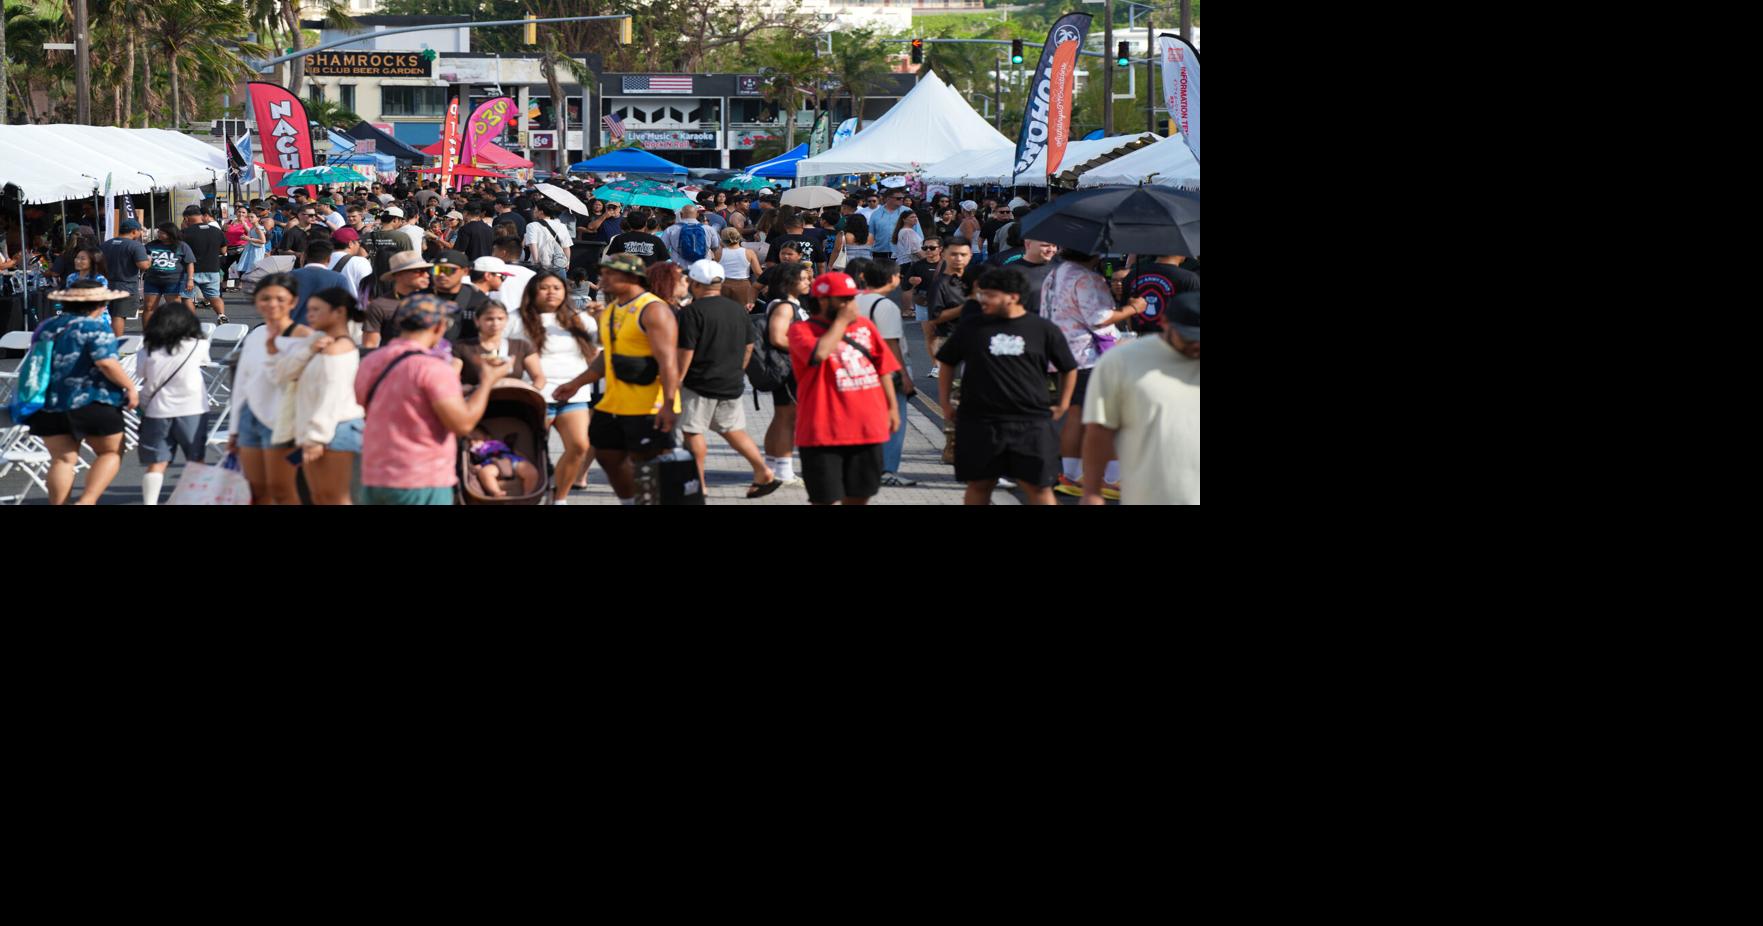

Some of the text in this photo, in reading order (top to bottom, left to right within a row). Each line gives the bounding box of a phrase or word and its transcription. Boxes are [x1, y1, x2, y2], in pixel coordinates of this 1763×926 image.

[305, 54, 418, 67] SHAMROCKS
[628, 132, 714, 140] Live Music Karaoke
[270, 100, 304, 203] NACH
